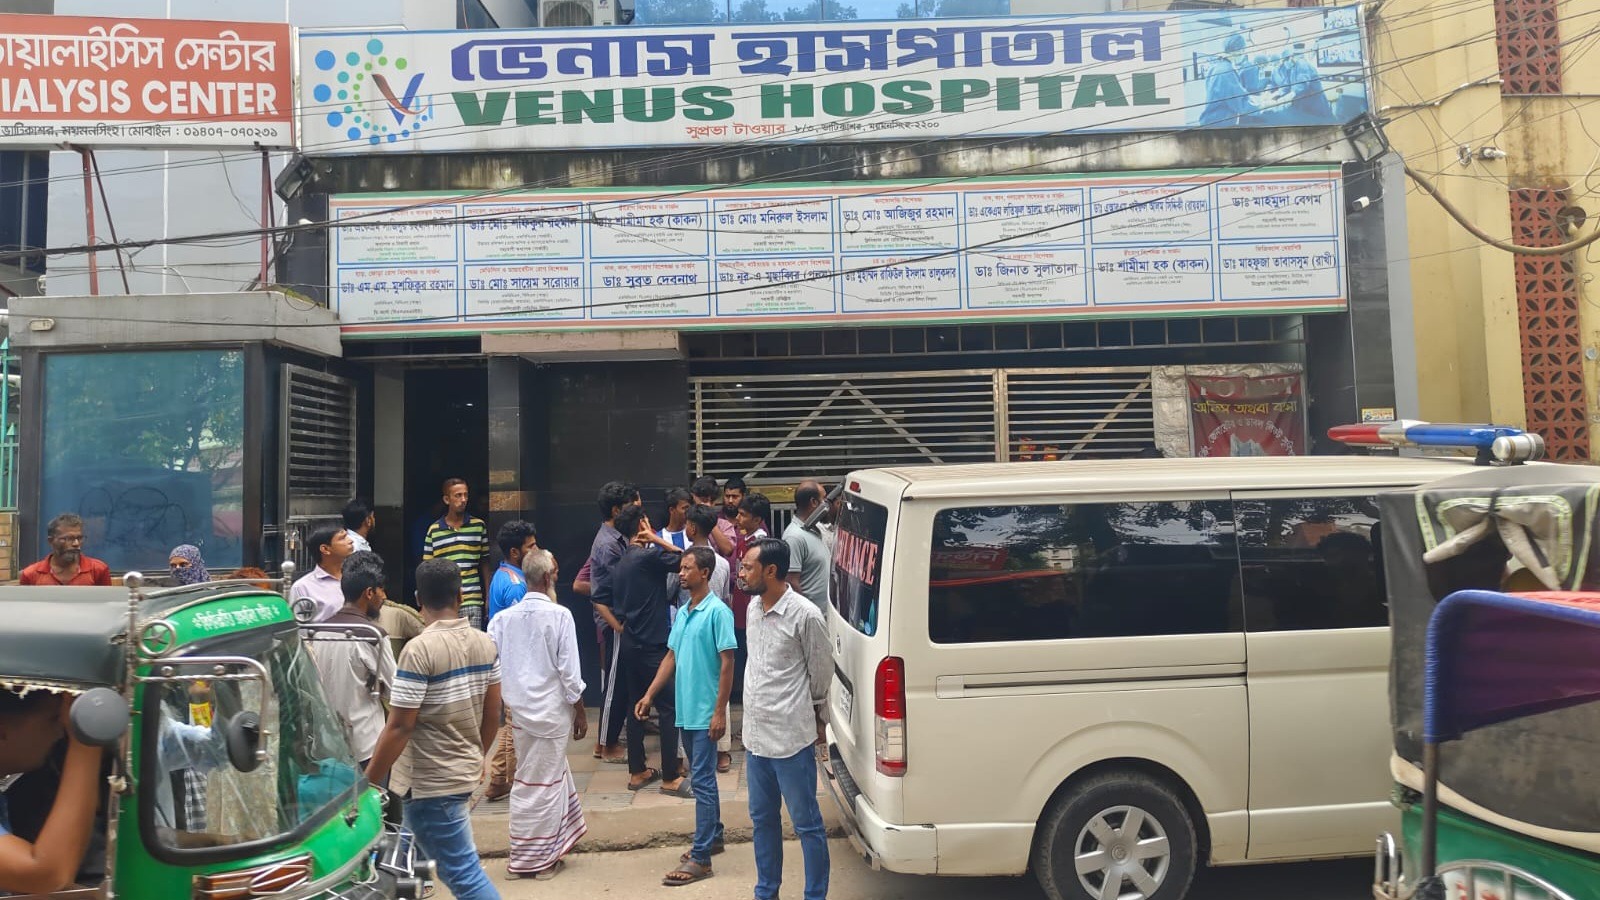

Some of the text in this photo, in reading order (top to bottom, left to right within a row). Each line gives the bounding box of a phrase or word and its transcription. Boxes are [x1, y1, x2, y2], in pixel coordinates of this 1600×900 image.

[0, 23, 276, 72] ায়ালাইসিস সেন্টার
[451, 21, 1166, 81] ভেনাস হাসপাতাল
[0, 78, 279, 115] IALYSIS CENTER
[450, 73, 1170, 126] VENUS HOSPITAL
[129, 124, 170, 137] মোবাইল
[686, 124, 727, 139] সুপ্রভা
[733, 122, 785, 135] টাওয়ার
[1294, 195, 1321, 205] বেগম
[719, 214, 735, 225] ডাঃ
[738, 214, 756, 224] মোঃ
[796, 209, 828, 223] ইসলাম
[883, 206, 922, 221] আজিজুর
[925, 207, 954, 220] রহমান
[975, 266, 992, 277] ডাঃ
[996, 262, 1029, 277] জিনাত
[1153, 261, 1169, 271] হক
[430, 280, 455, 291] রহমান
[470, 277, 579, 289] ডাঃ মোঃ সায়েম সরোয়ার
[602, 276, 621, 287] ডাঃ
[657, 274, 697, 285] দেবনাথ
